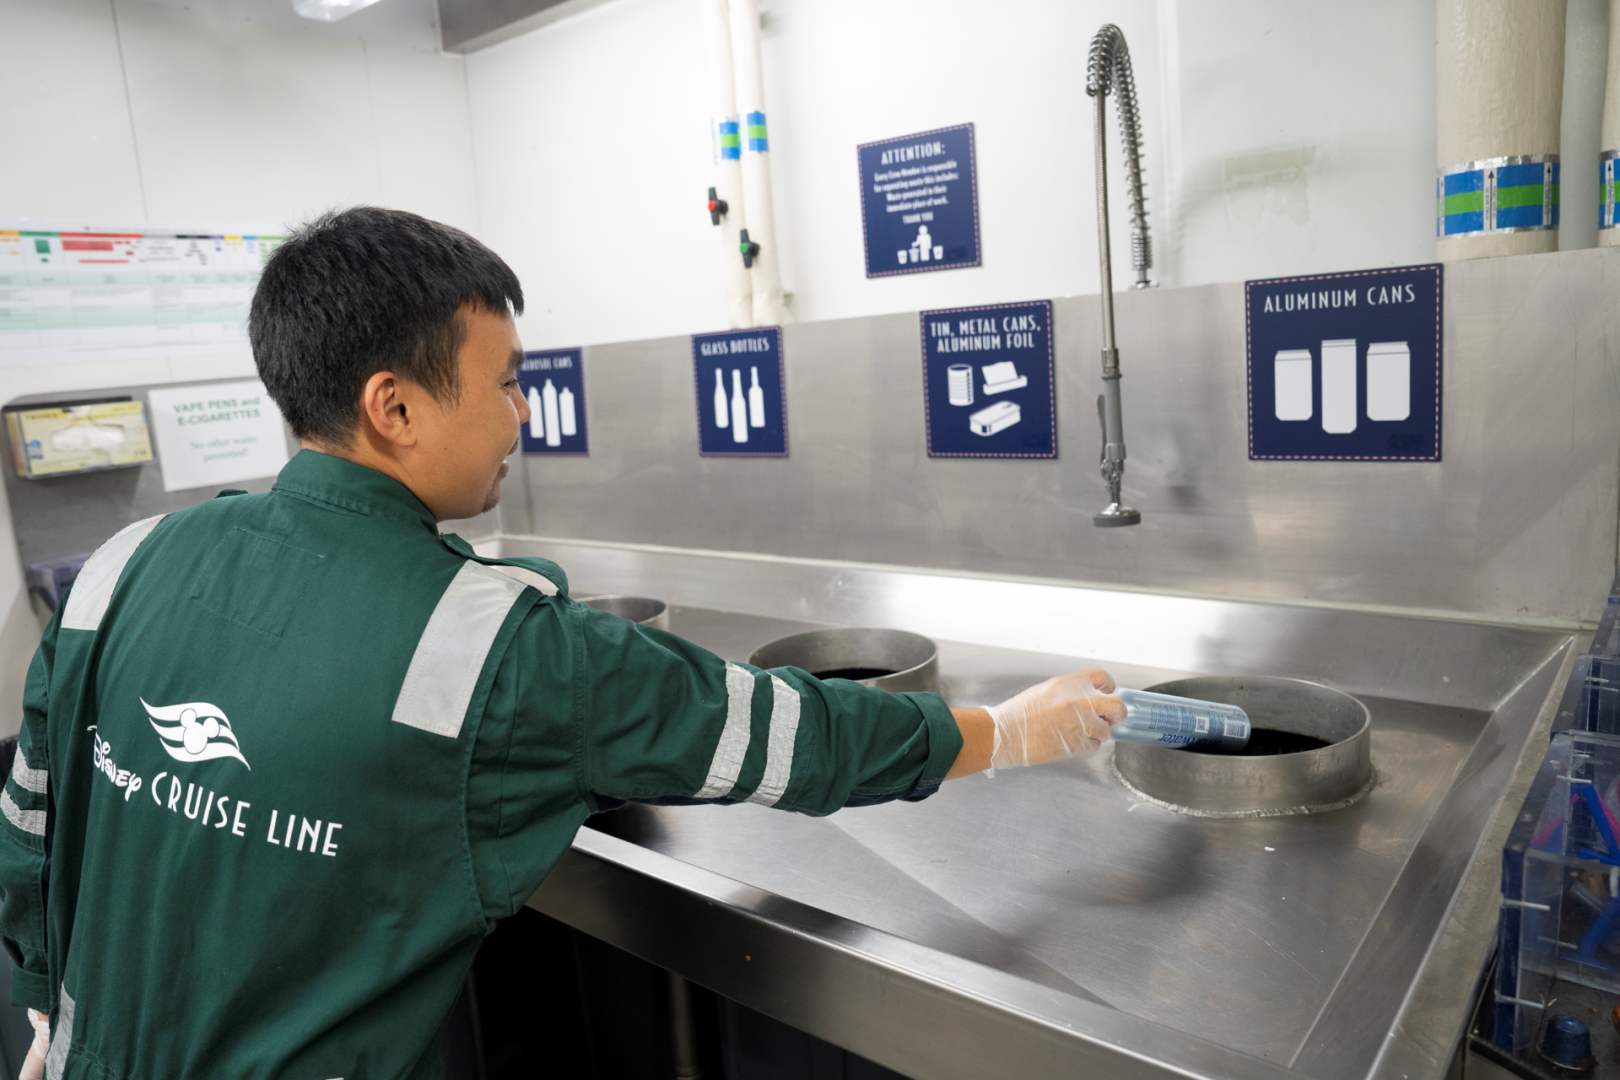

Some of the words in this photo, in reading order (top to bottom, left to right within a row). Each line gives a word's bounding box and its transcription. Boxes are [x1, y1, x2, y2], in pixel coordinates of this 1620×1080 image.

[881, 141, 946, 166] ATTENTION:
[927, 160, 958, 173] responsible
[909, 178, 924, 187] waste
[902, 214, 921, 224] THANK
[922, 212, 934, 222] YOU
[1264, 288, 1357, 313] ALUMINUM
[1366, 284, 1416, 306] CANS
[930, 322, 955, 339] TIN,
[959, 318, 998, 336] METAL
[1002, 314, 1041, 332] CANS,
[700, 340, 728, 356] GLASS
[730, 336, 770, 354] BOTTLES
[936, 334, 1001, 353] ALUMINUM
[1006, 332, 1035, 349] FOIL
[552, 356, 573, 369] CANS
[173, 401, 204, 413] VAPE
[208, 398, 238, 410] PENS
[242, 397, 260, 406] and
[177, 408, 261, 426] E-CIGARETTES
[190, 440, 205, 450] No
[208, 438, 230, 448] other
[1157, 733, 1222, 748] smartwater
[87, 724, 142, 802] Disney
[151, 771, 251, 837] CRUISE
[266, 809, 343, 858] LINE
